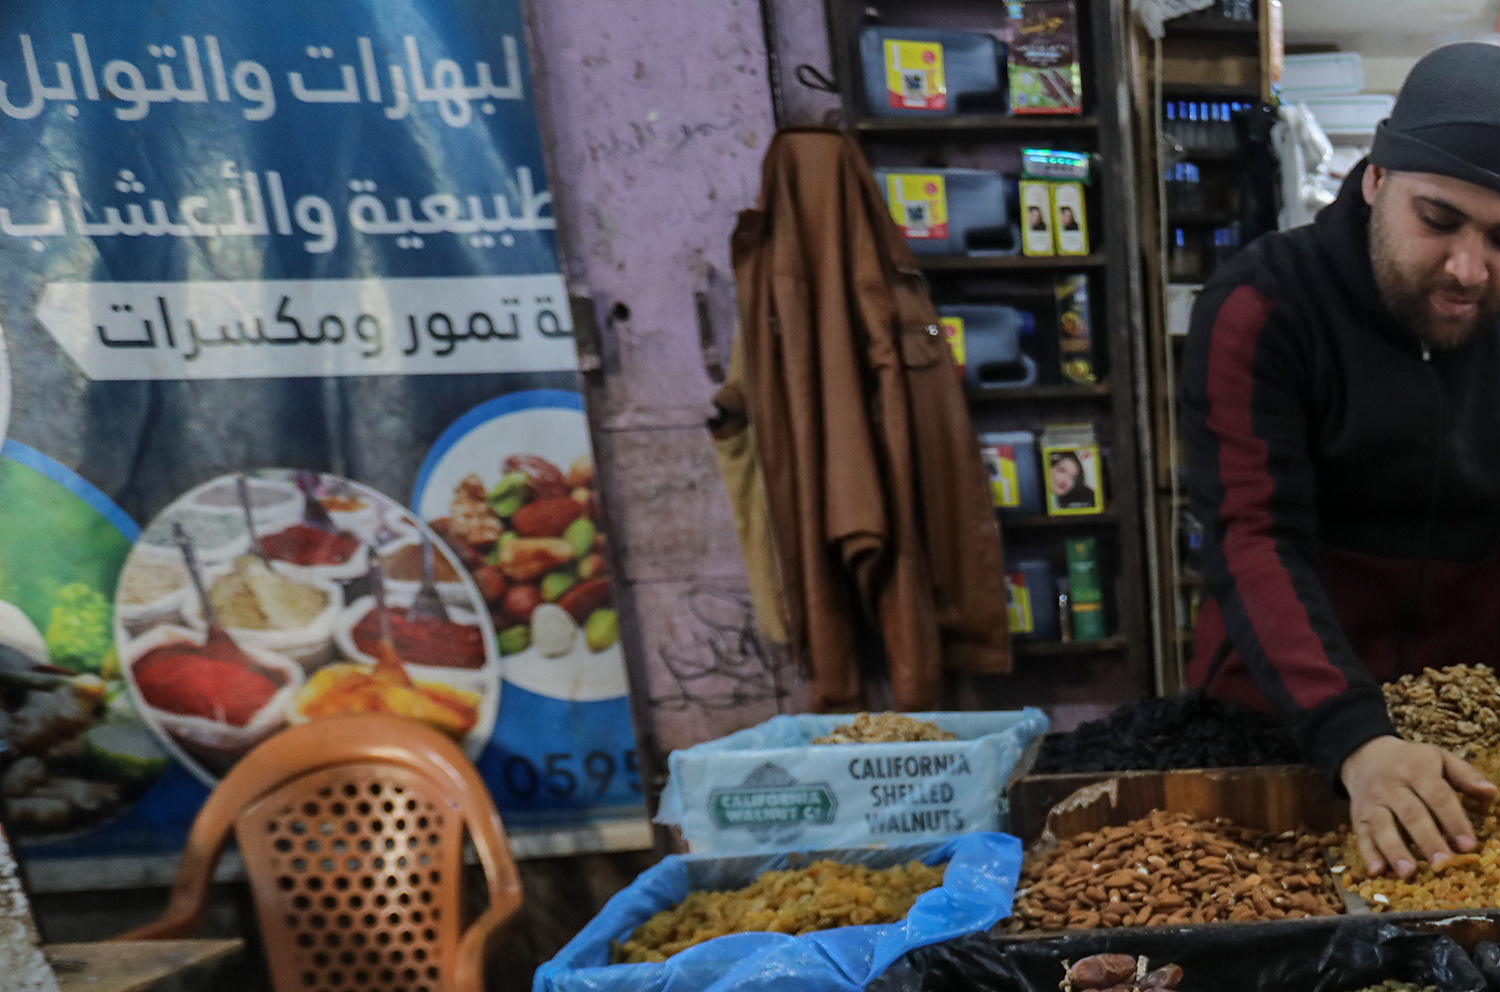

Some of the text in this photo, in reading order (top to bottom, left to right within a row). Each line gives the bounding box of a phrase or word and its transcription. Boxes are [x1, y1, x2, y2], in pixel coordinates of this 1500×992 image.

[97, 294, 383, 362] ومكسرات
[402, 297, 521, 358] تمور
[848, 754, 970, 780] CALIFORNIA
[720, 790, 823, 808] CALIFORNIA
[870, 785, 954, 807] SHELLED
[725, 807, 801, 823] WALNUT
[866, 808, 966, 835] WALNUTS
